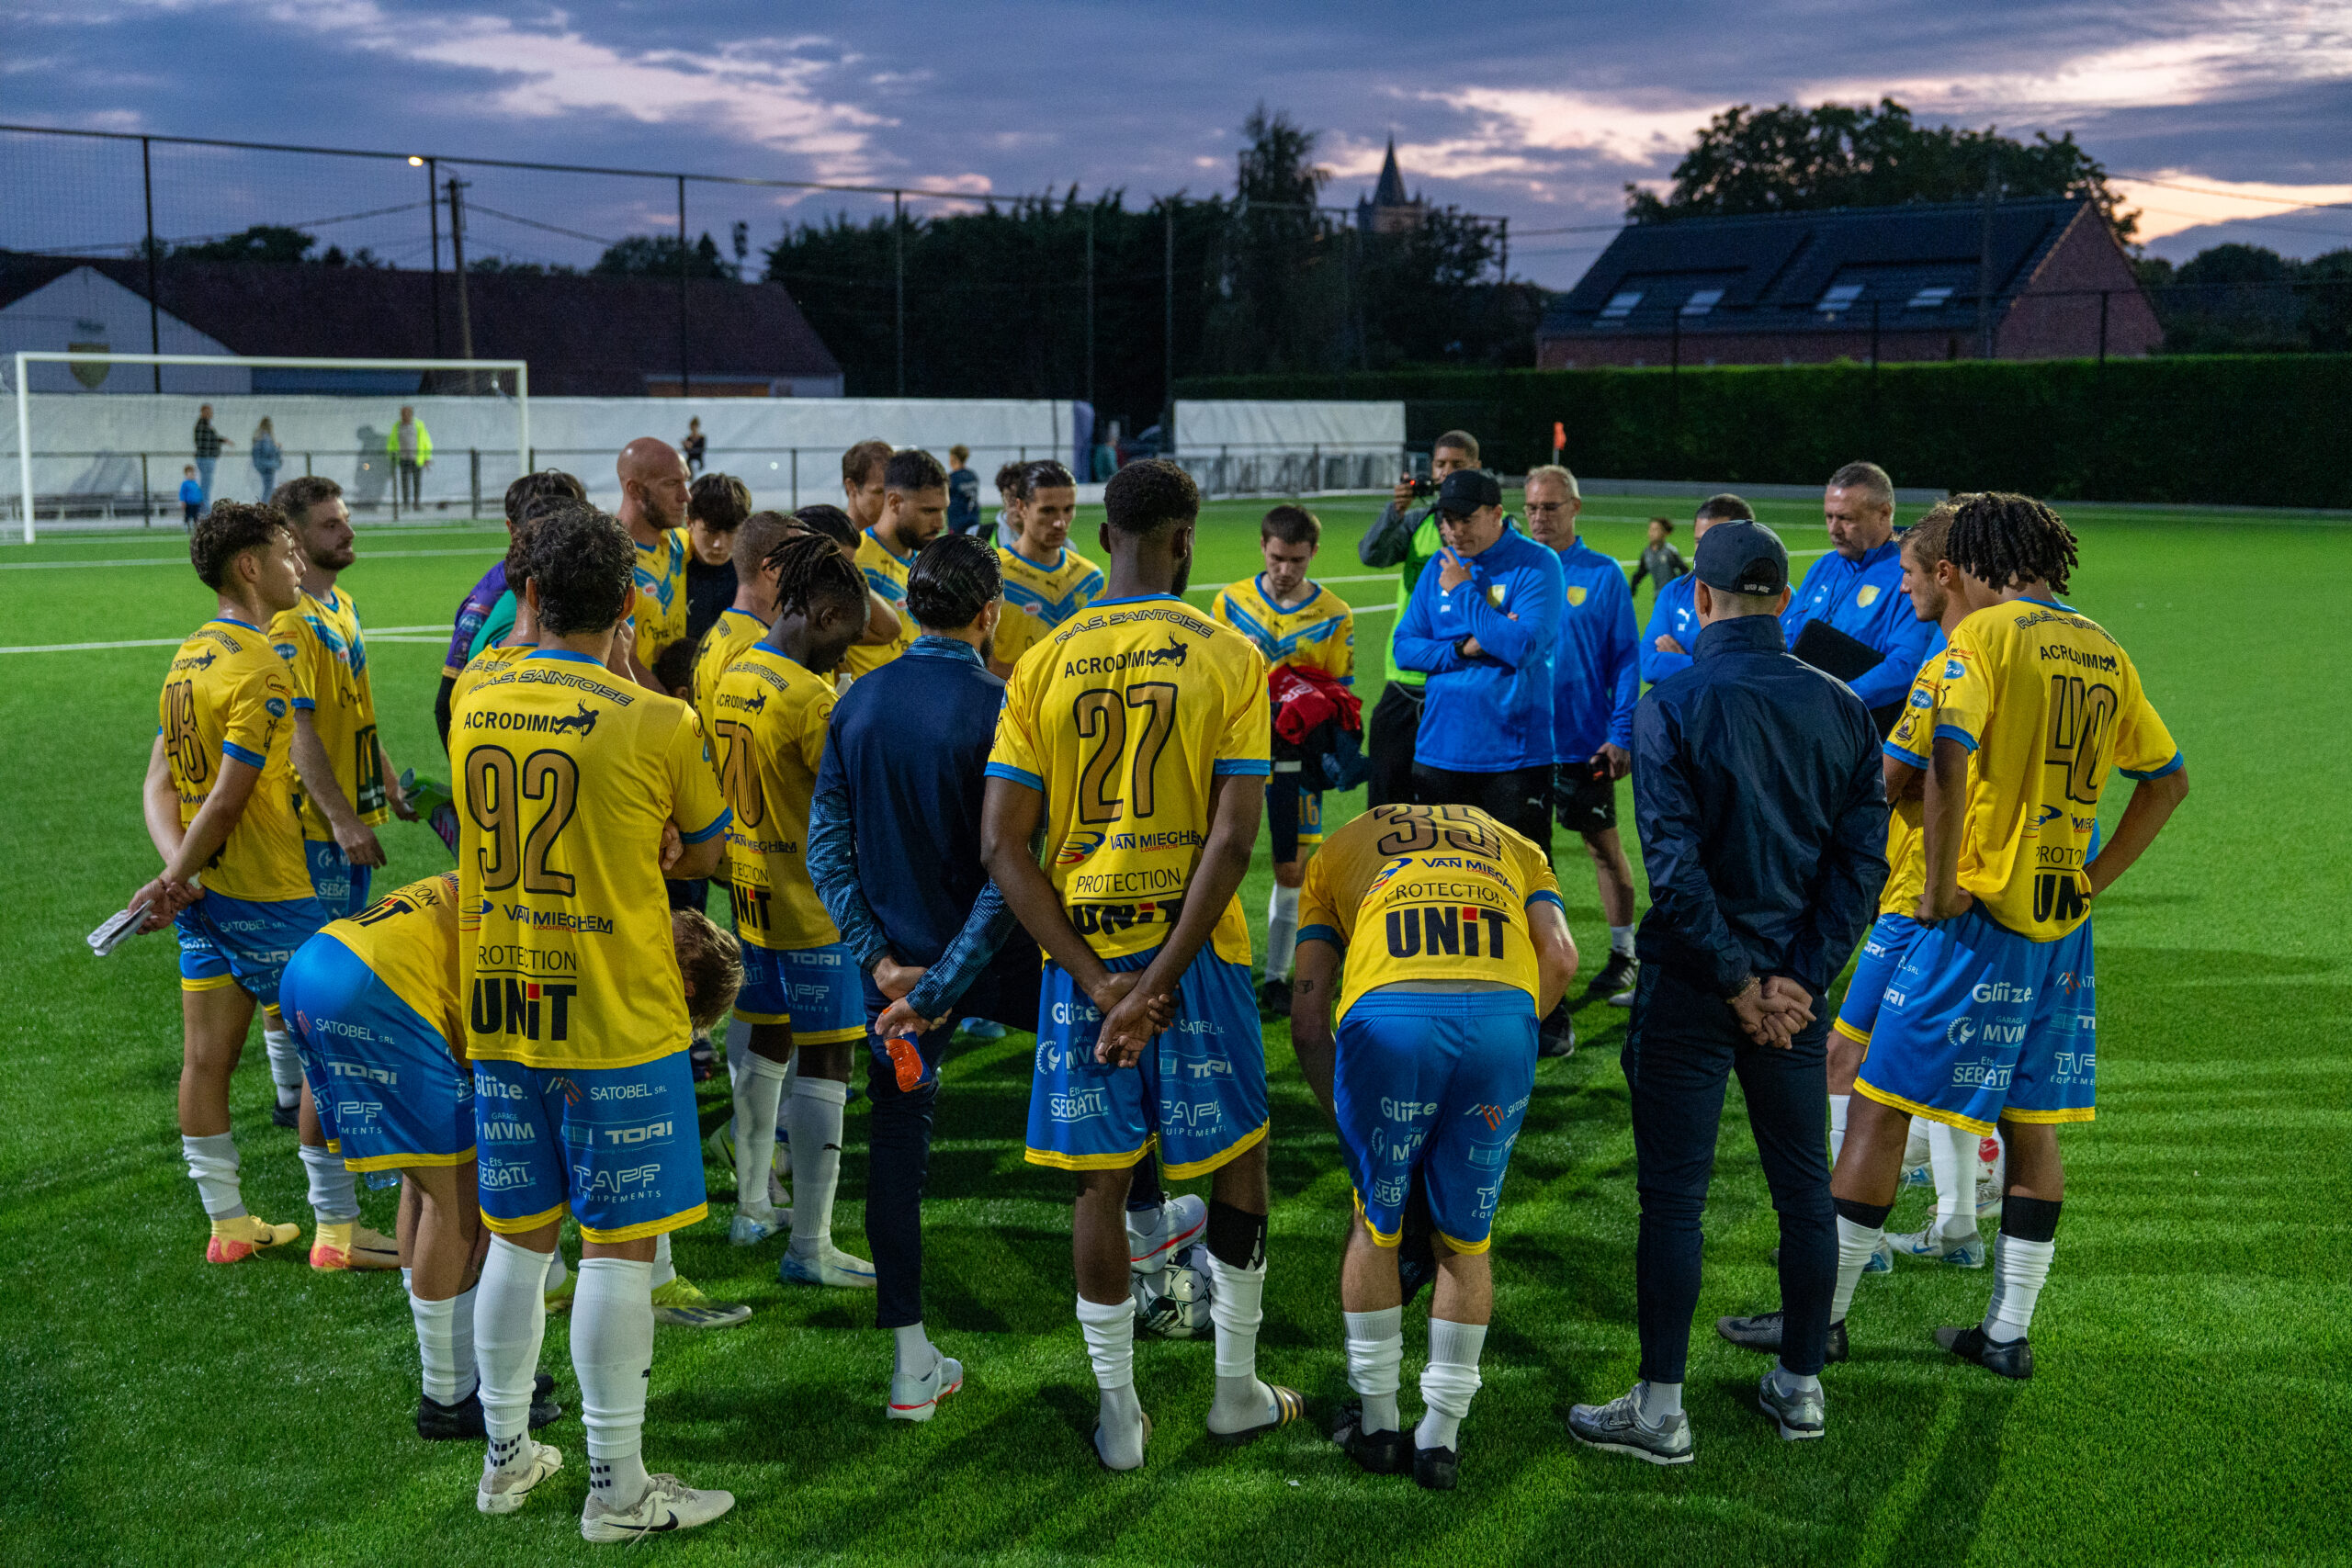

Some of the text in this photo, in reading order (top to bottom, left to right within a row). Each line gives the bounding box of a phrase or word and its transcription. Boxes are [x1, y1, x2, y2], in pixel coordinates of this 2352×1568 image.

[1110, 609, 1214, 638] SAINTOISE
[518, 669, 635, 707] SAINTOISE
[1073, 682, 1179, 825] 27
[715, 719, 764, 829] 70
[465, 744, 581, 898] 92
[1110, 833, 1136, 851] VAN
[1140, 844, 1179, 853] LOGISTICS
[1421, 858, 1462, 868] VAN
[1075, 867, 1182, 893] PROTECTION
[220, 919, 266, 933] SATOBEL
[502, 904, 613, 934] VAN MIEGHEM
[787, 952, 842, 966] TORI
[315, 1018, 396, 1045] SATOBEL SRL
[327, 1061, 399, 1086] TORI
[590, 1083, 668, 1101] SATOBEL SRL
[491, 1111, 519, 1122] GARAGE
[1050, 1093, 1102, 1119] SEBATI
[483, 1122, 536, 1141] MVM
[604, 1121, 673, 1145] TORI
[489, 1156, 503, 1167] Ets
[478, 1165, 529, 1187] SEBATI
